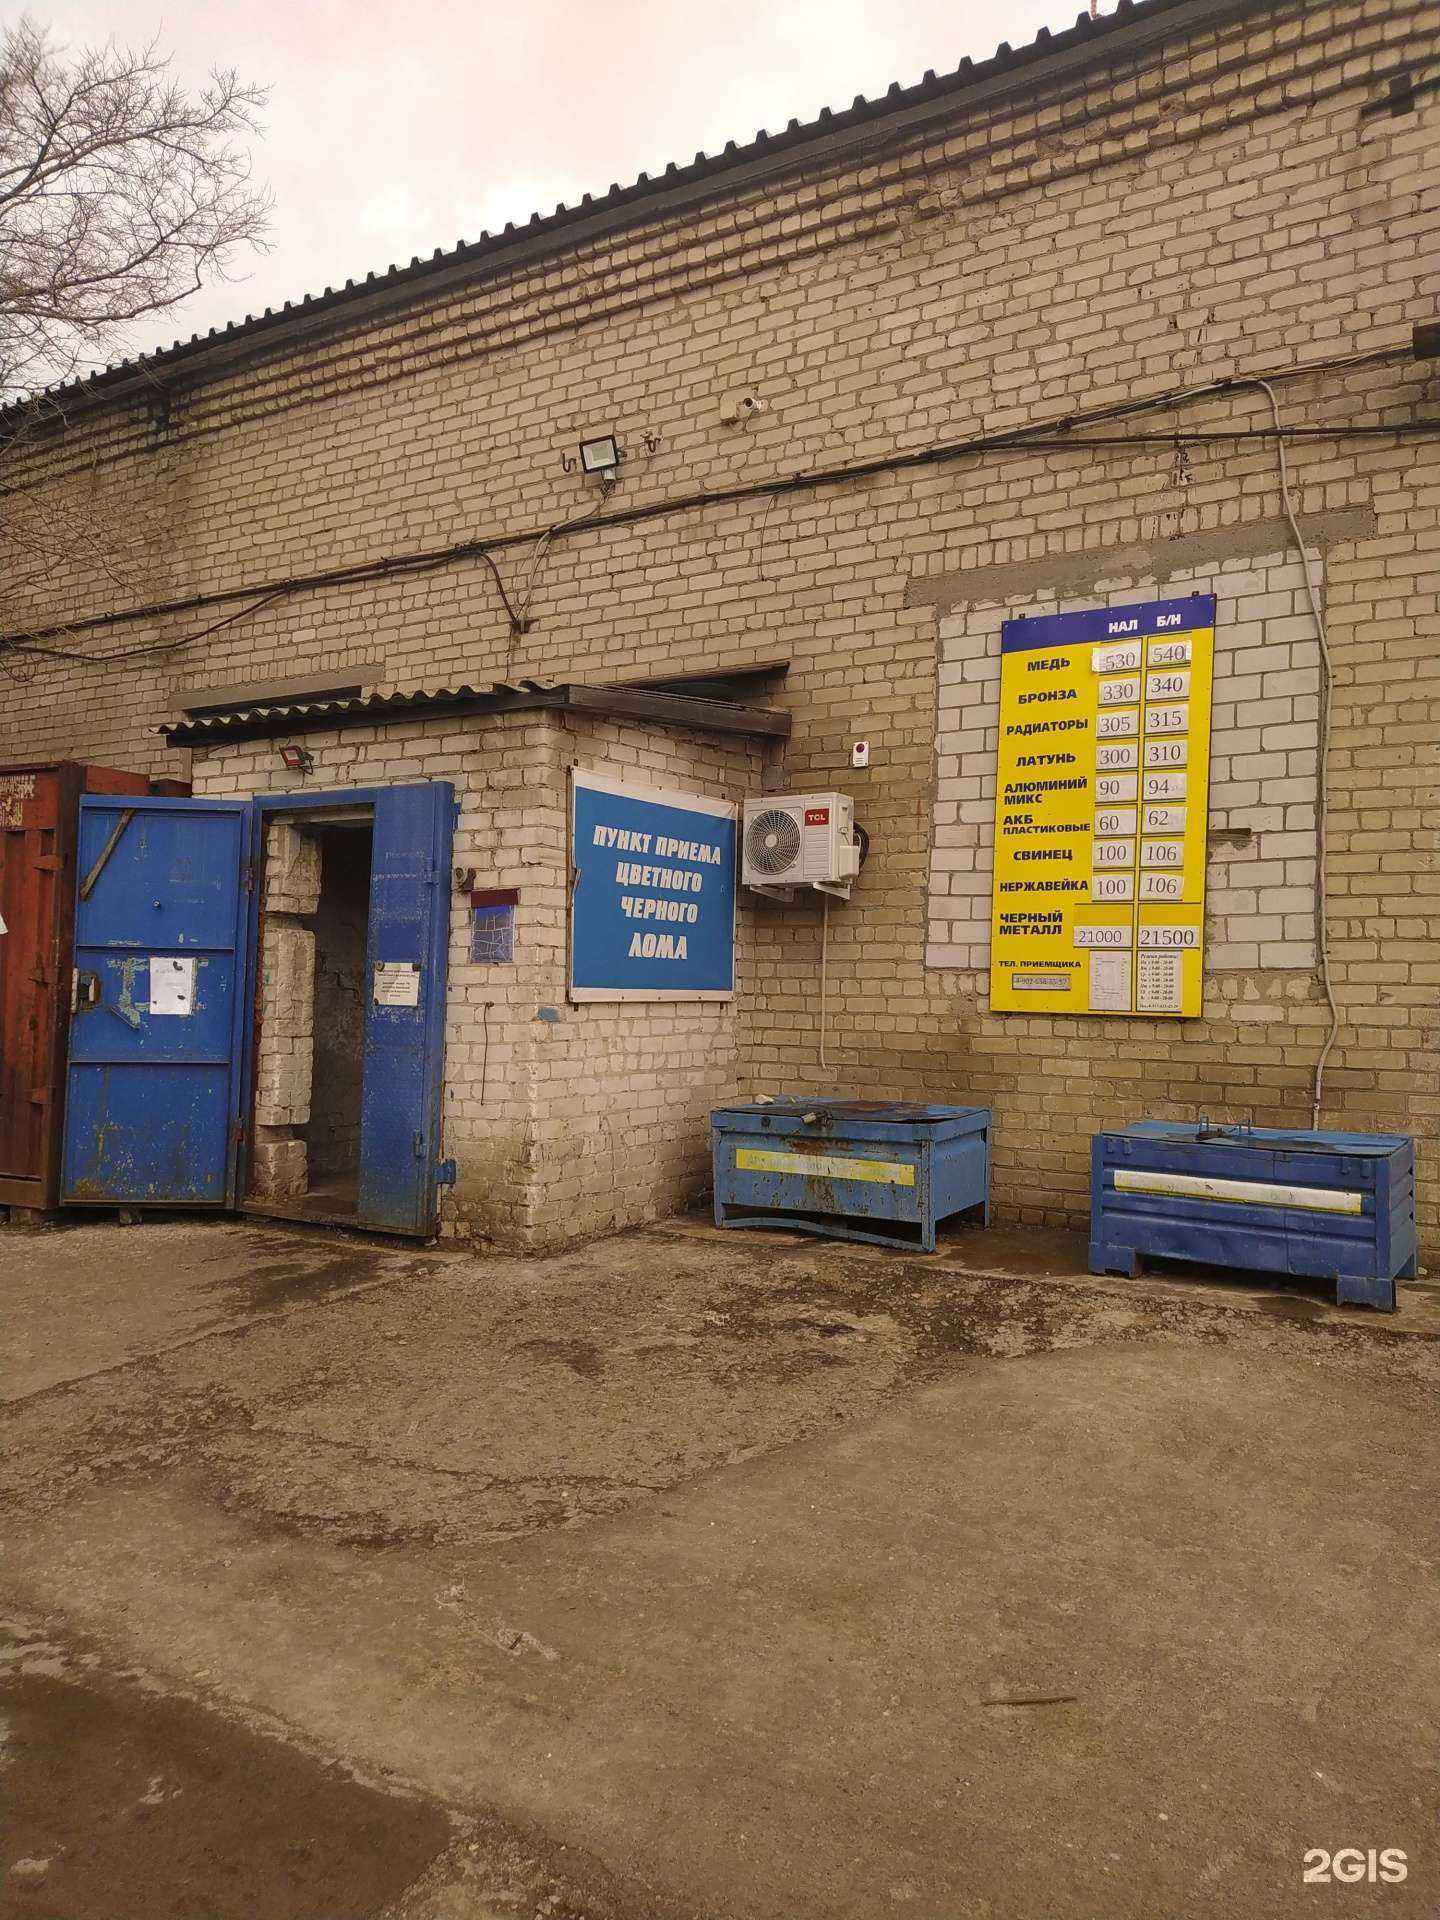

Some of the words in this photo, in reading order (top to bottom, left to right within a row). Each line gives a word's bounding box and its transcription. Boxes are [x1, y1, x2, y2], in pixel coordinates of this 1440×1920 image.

[1108, 619, 1138, 634] НАЛ
[1156, 613, 1182, 627] Б/Н
[1027, 657, 1071, 672] МЕДЬ
[1105, 651, 1136, 671] 530
[1152, 645, 1186, 663] 540
[1018, 688, 1078, 705] БРОНЗА
[1103, 683, 1133, 700] 330
[1151, 676, 1183, 692] 340
[1006, 718, 1089, 736] РАДИАТОРЫ
[1099, 716, 1131, 733] 305
[1150, 710, 1182, 728] 315
[1016, 753, 1076, 767] ЛАТУНЬ
[1099, 748, 1131, 765] 300
[1149, 744, 1181, 762] 310
[1004, 776, 1088, 794] АЛЮМИНИЙ
[1099, 779, 1120, 796] 90
[1148, 778, 1169, 795] 94
[1004, 793, 1043, 805] МИКС
[807, 813, 826, 821] TCL
[1003, 814, 1034, 826] АКБ
[1099, 815, 1119, 831] 60
[1148, 810, 1169, 826] 62
[1003, 823, 1091, 835] ПЛАСТИКОВЫЕ
[592, 824, 652, 854] ПУНКТ
[655, 835, 721, 865] ПРИЕМА
[1013, 849, 1073, 862] СВИНЕЦ
[1097, 845, 1127, 861] 100
[1146, 845, 1177, 862] 106
[615, 861, 703, 893] ЦВЕТНОГО
[1000, 878, 1089, 892] НЕРЖАВЕЙКА
[1098, 879, 1126, 895] 100
[1145, 877, 1177, 894] 106
[621, 895, 699, 924] ЧЕРНОГО
[1000, 909, 1063, 923] ЧЕРНЫЙ
[1000, 924, 1062, 935] МЕТАЛЛ
[1078, 930, 1122, 944] 21000
[1140, 929, 1194, 946] 21500
[628, 932, 688, 960] ЛОМА
[998, 960, 1018, 968] ТЕЛ.
[1020, 960, 1082, 969] ПРИЕМЩИКА
